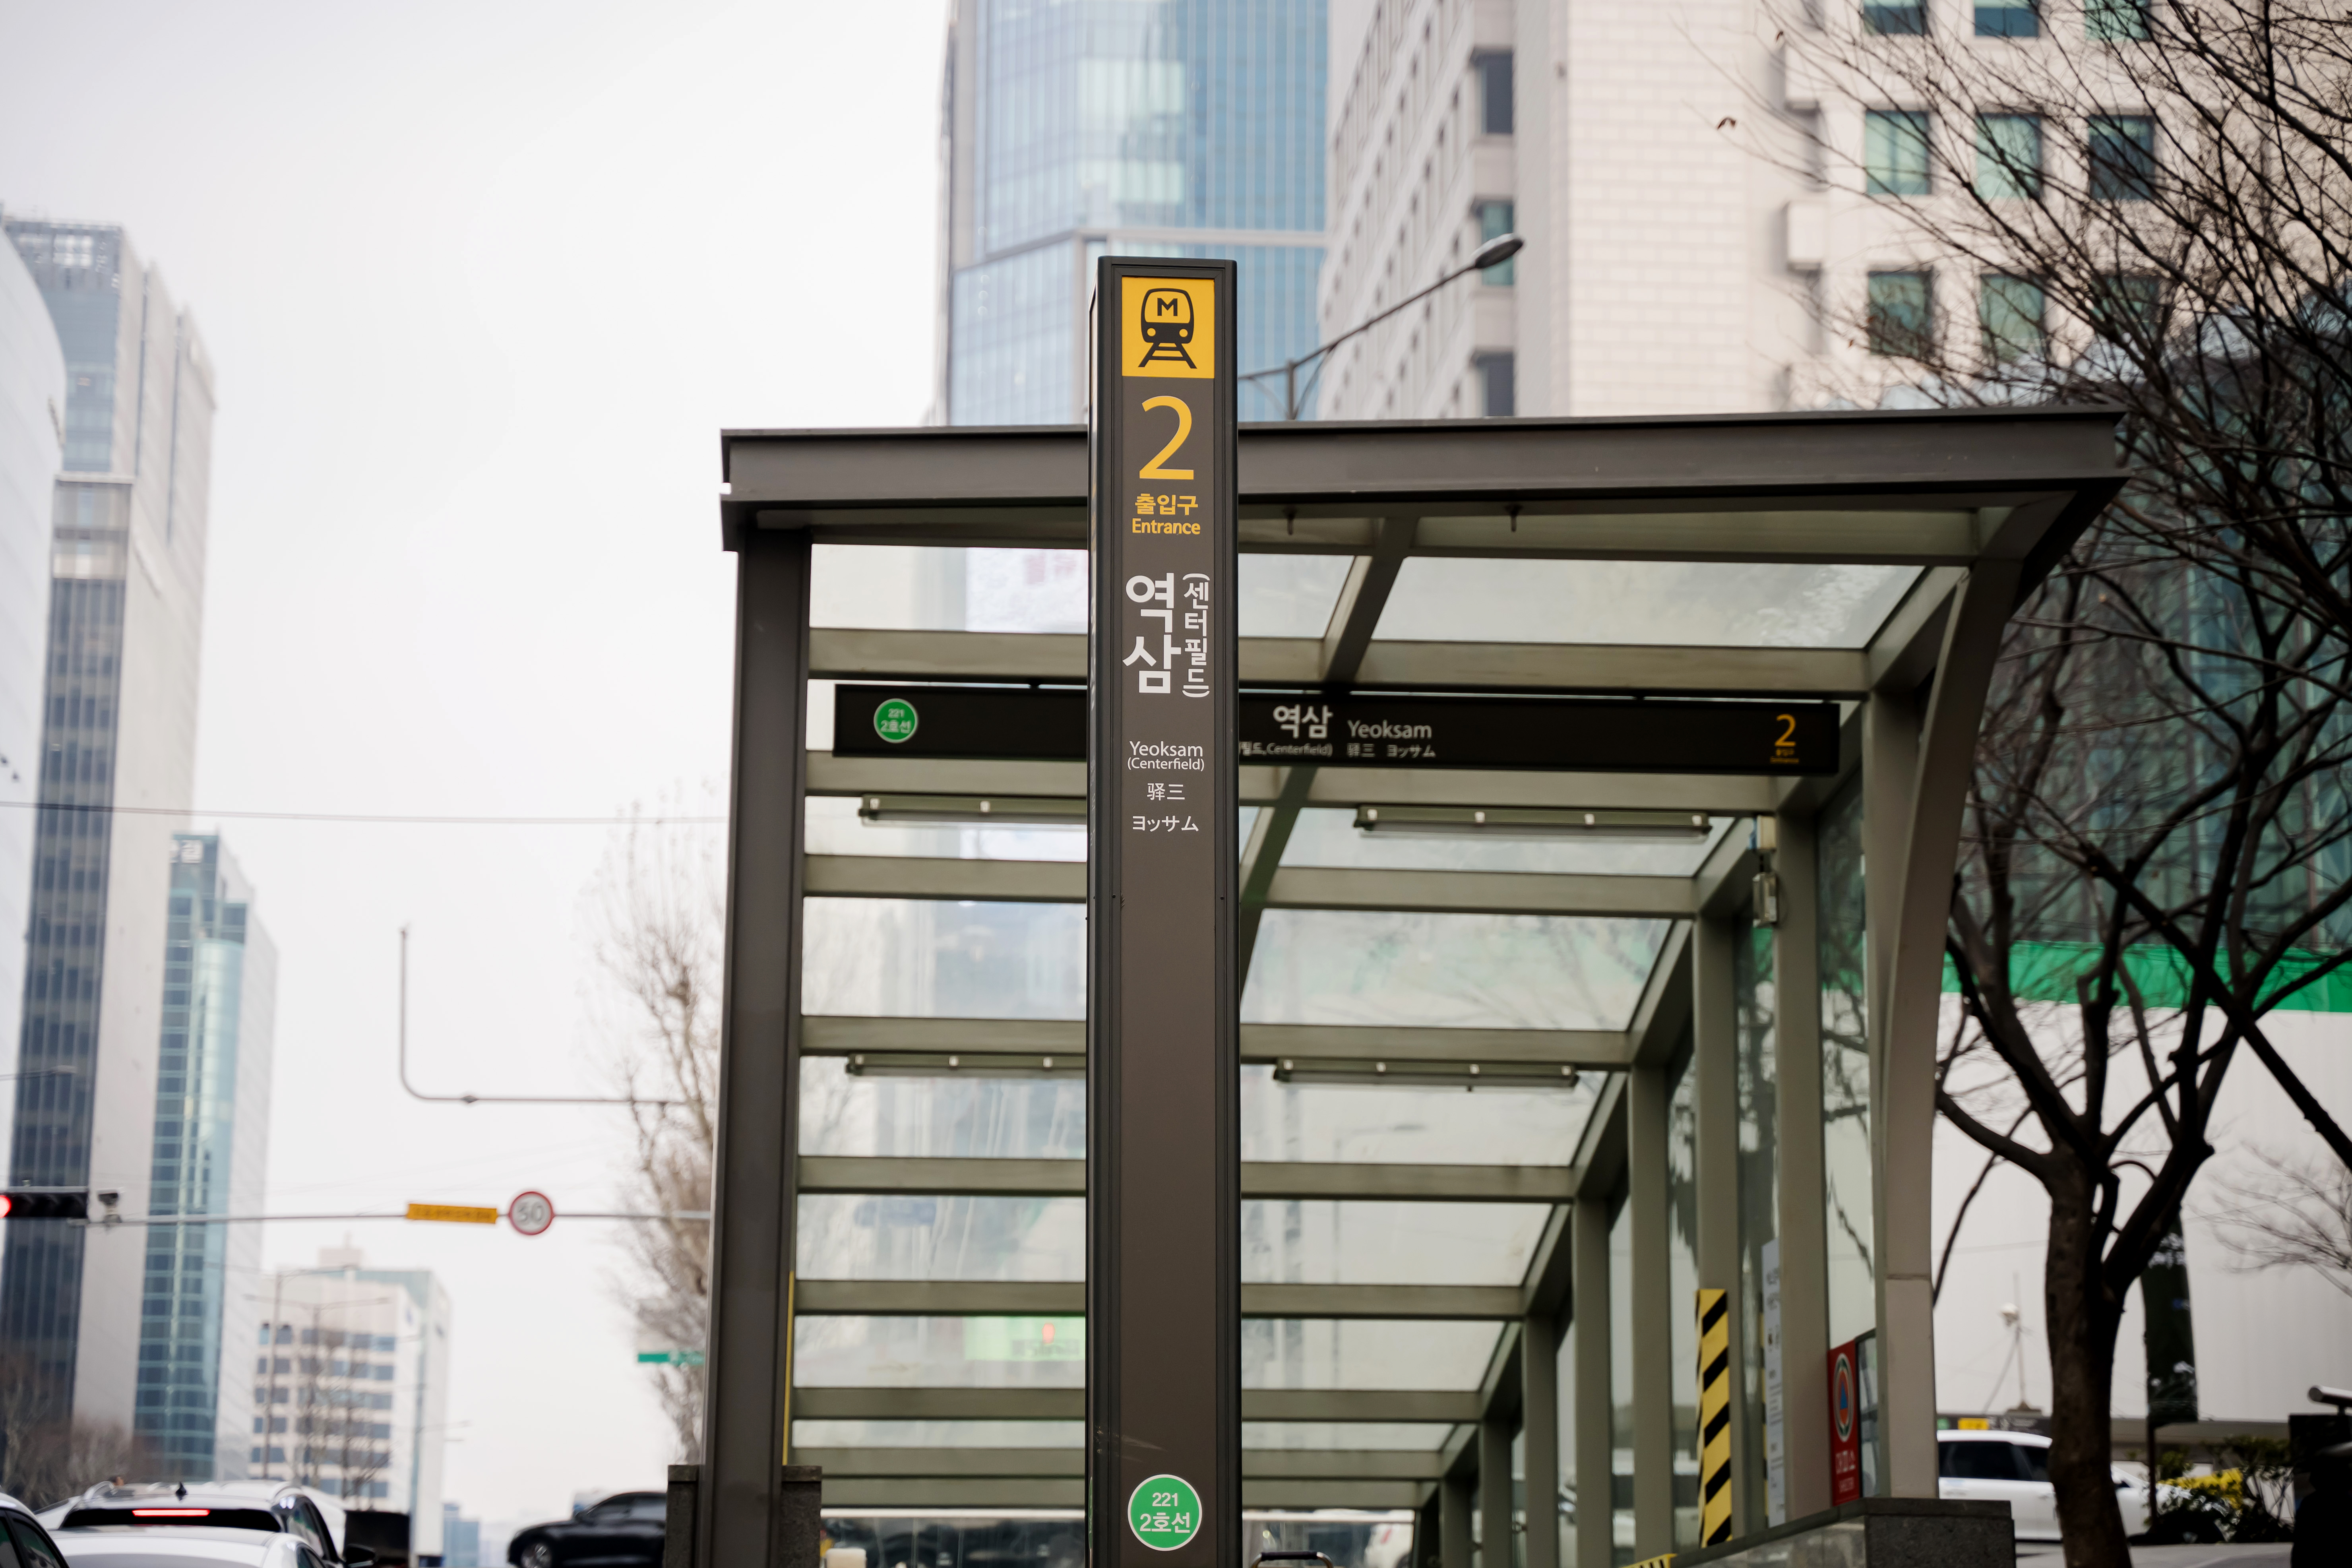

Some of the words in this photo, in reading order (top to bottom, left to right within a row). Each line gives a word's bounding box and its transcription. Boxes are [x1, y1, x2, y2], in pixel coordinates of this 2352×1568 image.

[1157, 297, 1178, 317] M
[1139, 395, 1194, 480] 2
[1135, 493, 1198, 516] 출입구
[1132, 518, 1201, 535] Entrance
[1122, 572, 1182, 694] 역삼
[1182, 573, 1211, 698] (센터필드)
[888, 708, 905, 718] 221
[1273, 704, 1334, 739] 역삼
[880, 719, 912, 734] 2호선
[1347, 719, 1432, 739] Yeoksam
[1774, 713, 1796, 747] 2
[1129, 740, 1203, 757] Yeoksam
[1127, 757, 1205, 772] (Centerfield)
[1147, 783, 1185, 801] 驿三
[1132, 815, 1199, 832] ヨッサム
[1152, 1492, 1178, 1507] 221
[1139, 1512, 1190, 1533] 2호선
